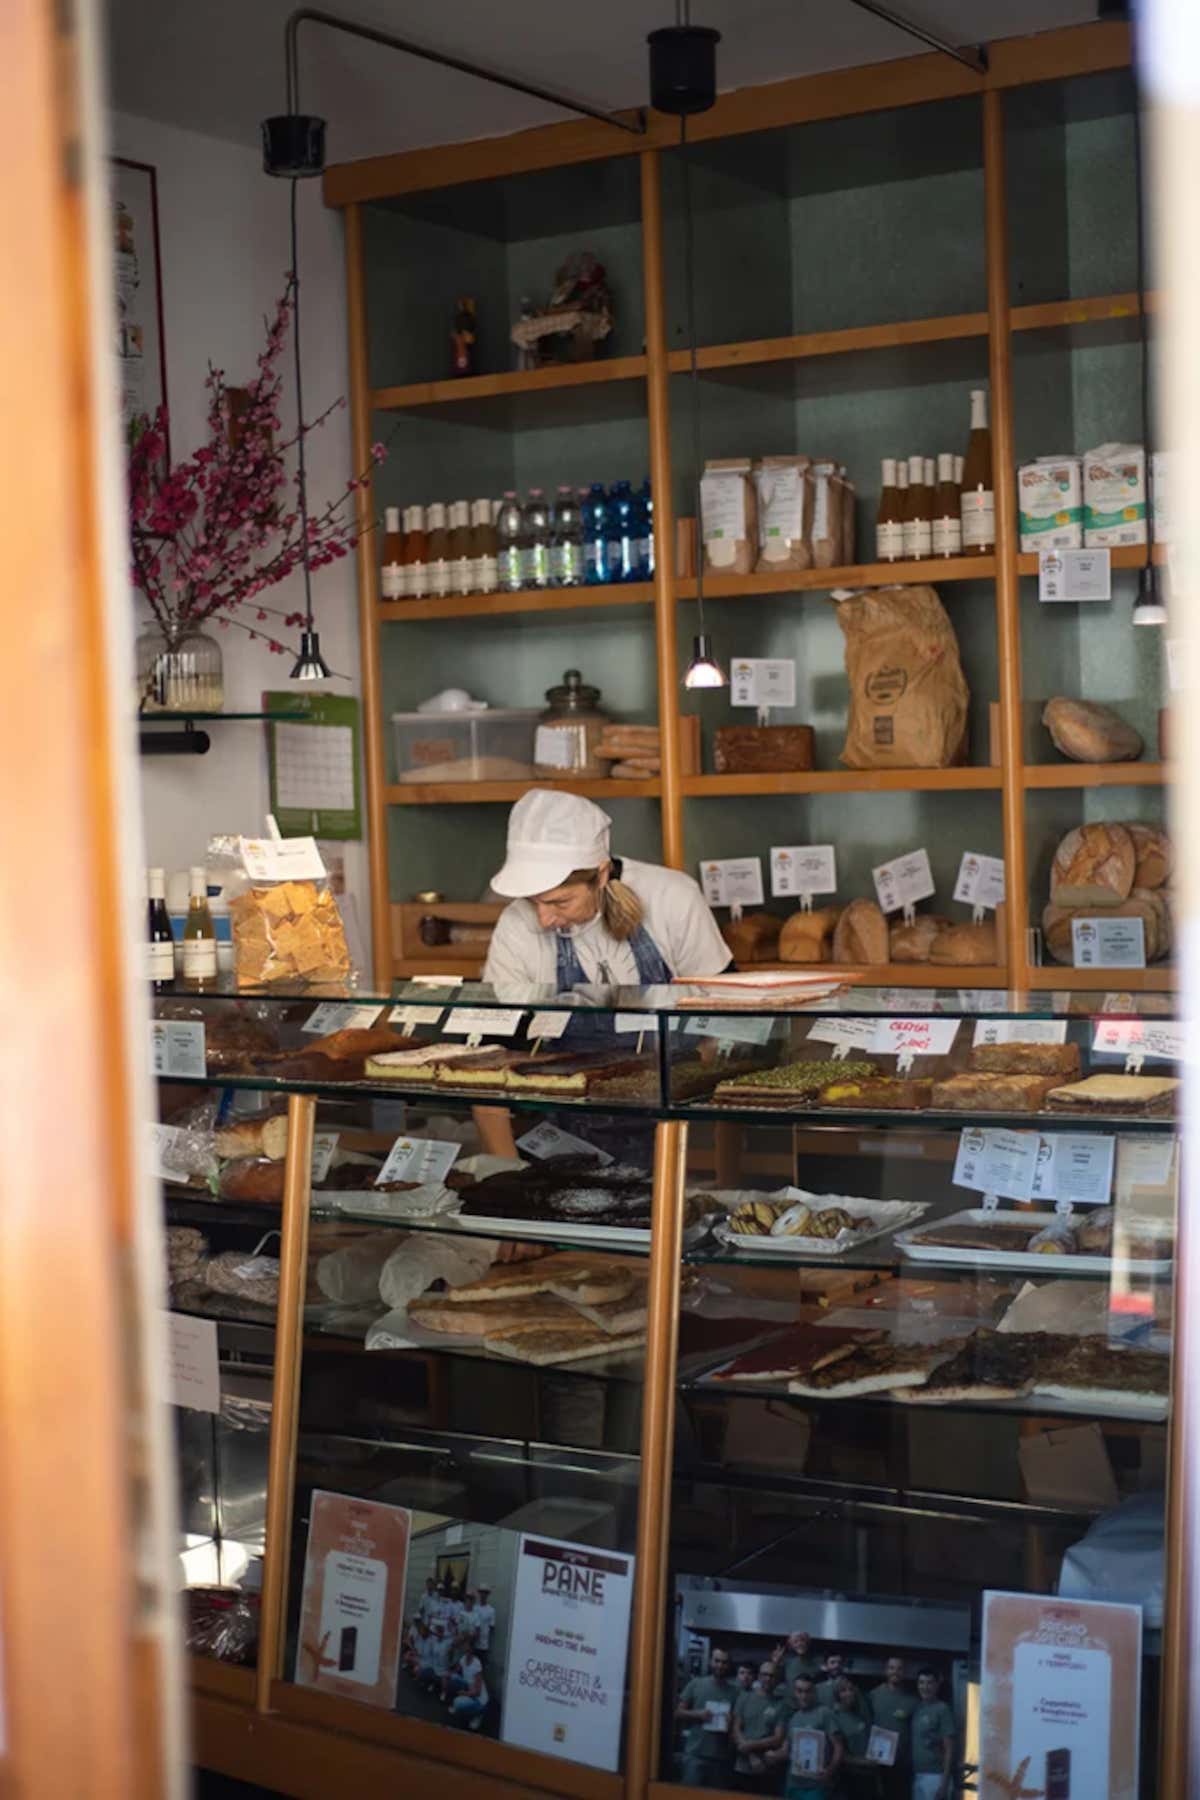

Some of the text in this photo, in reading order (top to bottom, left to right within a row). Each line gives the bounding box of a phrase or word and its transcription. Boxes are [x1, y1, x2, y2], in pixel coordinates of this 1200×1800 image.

[543, 1562, 606, 1598] PANE
[519, 1671, 608, 1706] BONGIOVANNI
[526, 1658, 602, 1690] CAPPELLETTI &
